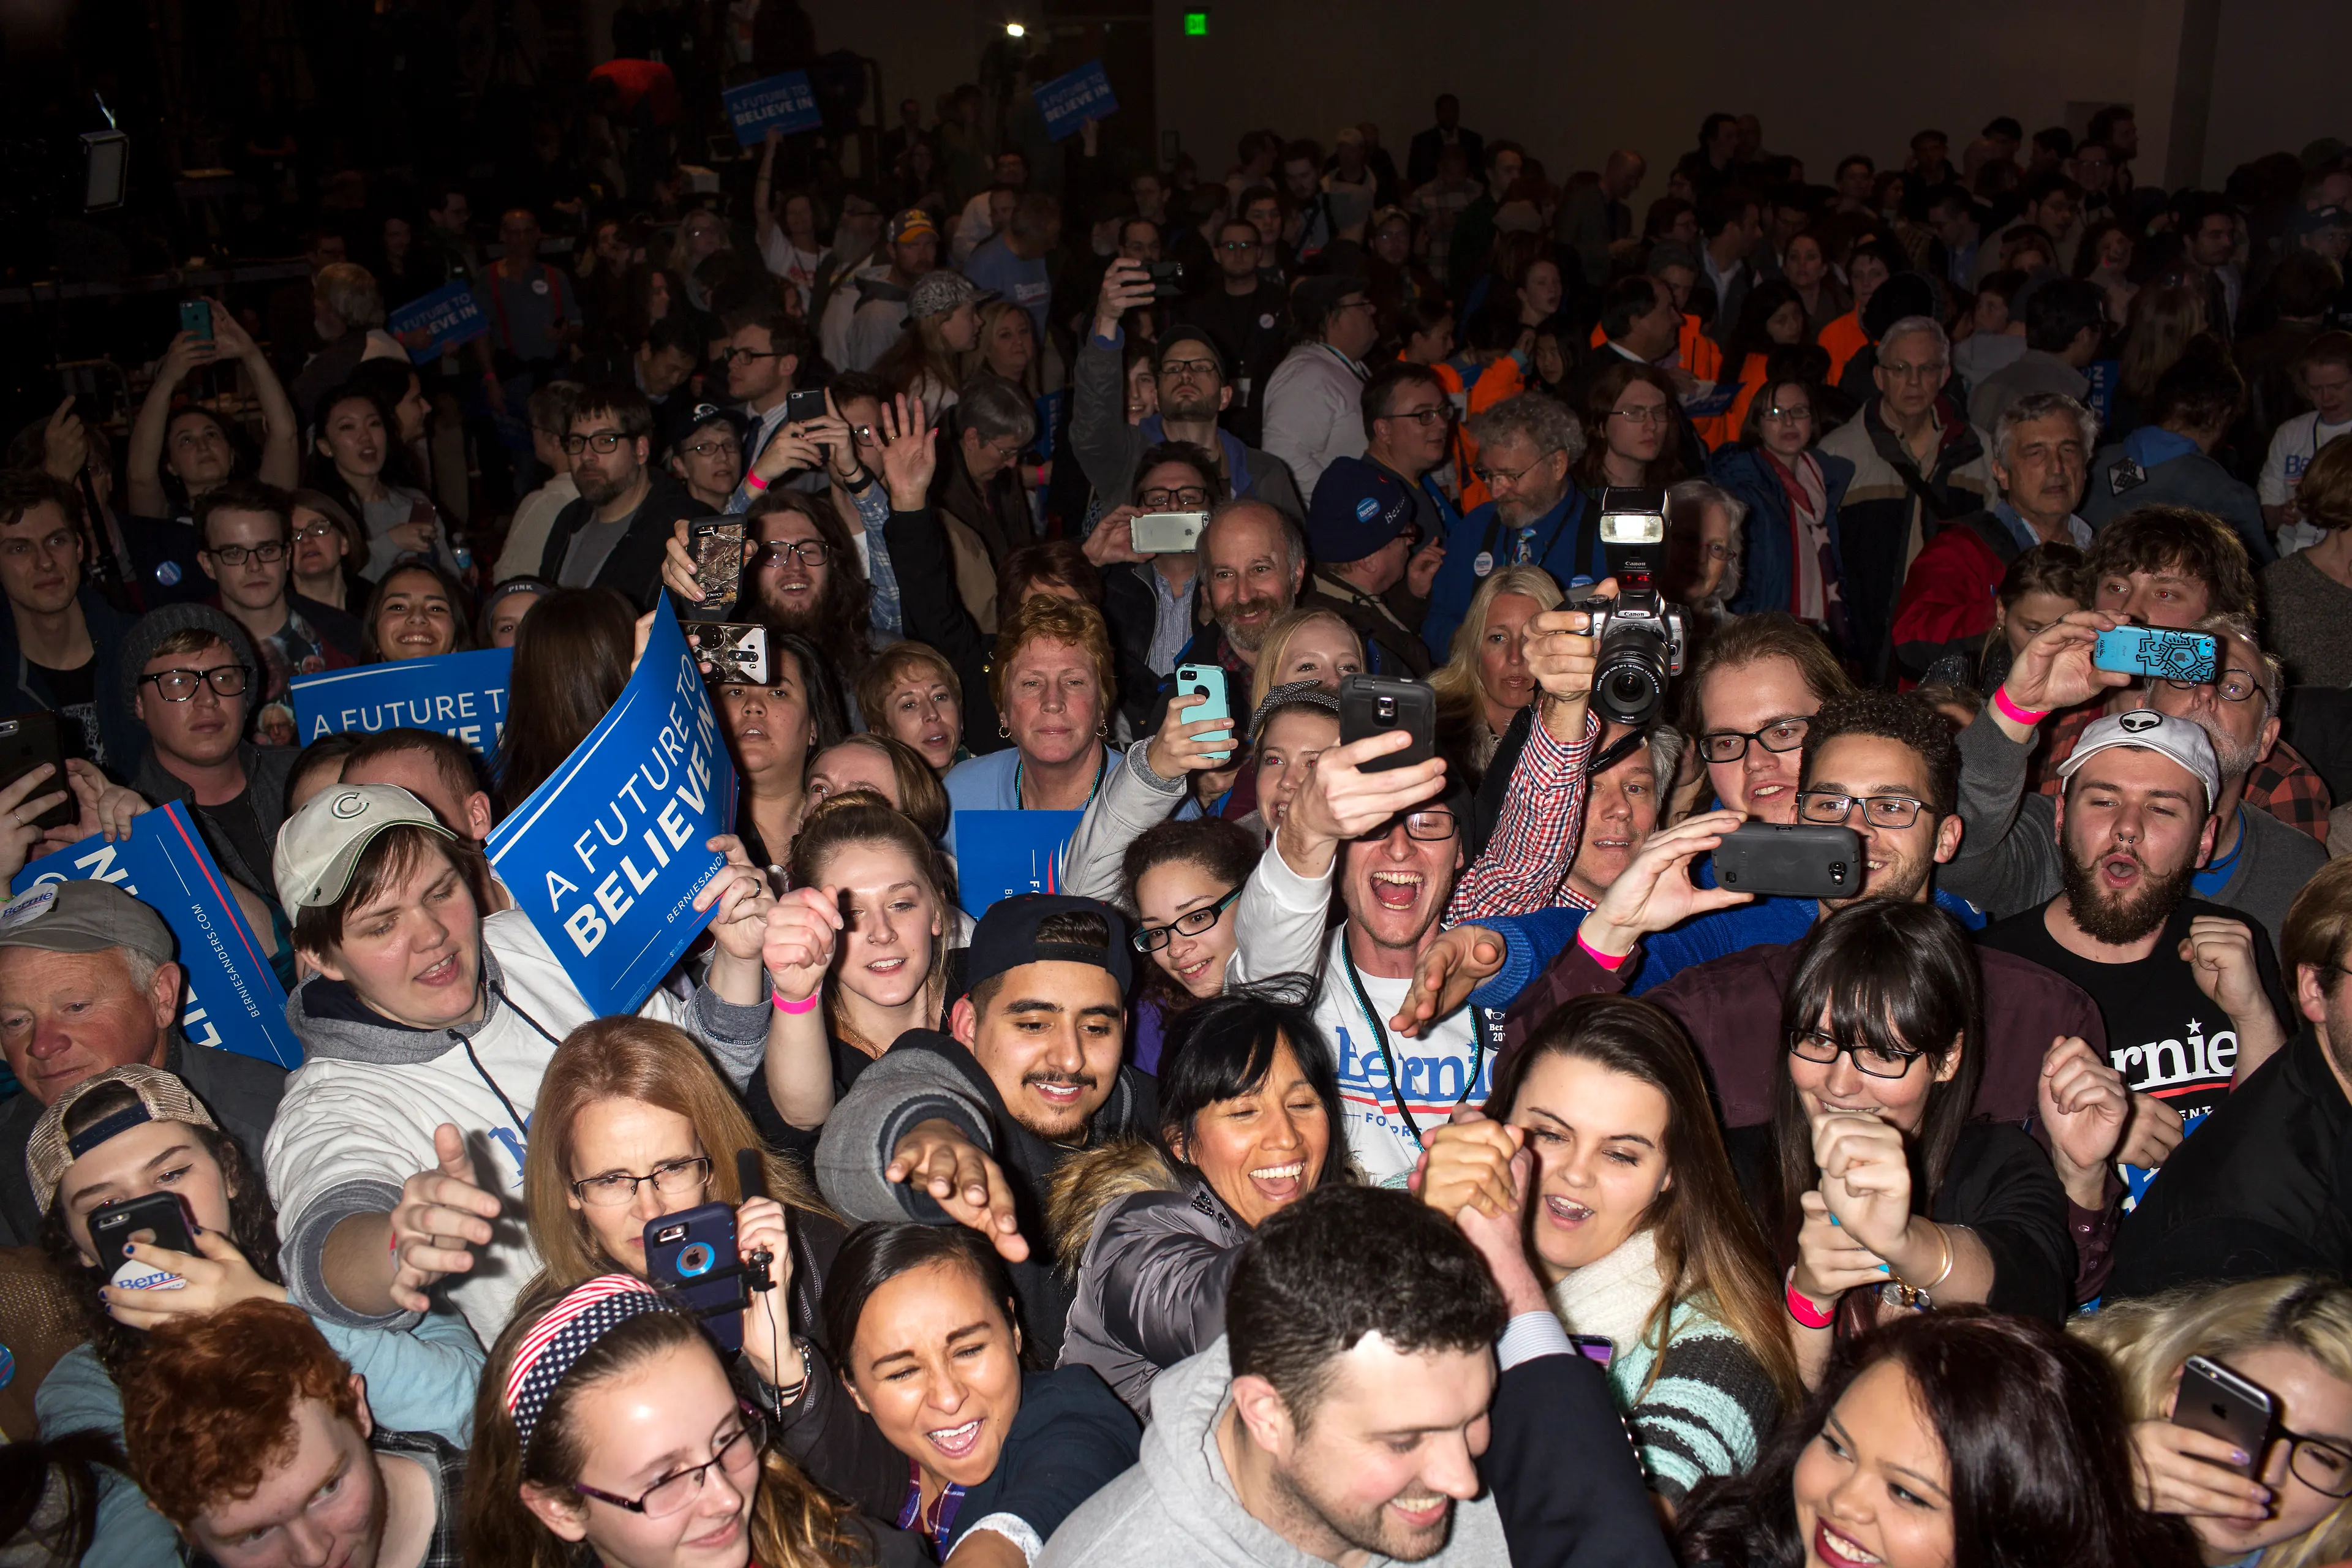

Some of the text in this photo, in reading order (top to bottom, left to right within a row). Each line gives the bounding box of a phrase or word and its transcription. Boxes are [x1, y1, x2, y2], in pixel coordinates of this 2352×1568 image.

[732, 83, 809, 111] A FUTURE TO
[1044, 83, 1110, 123] BELIEVE IN
[1048, 80, 1088, 106] FUTURE
[734, 96, 814, 126] BELIEVE IN
[402, 300, 451, 330] FUTURE
[451, 293, 470, 307] TO
[459, 303, 478, 321] IN
[508, 584, 533, 593] PINK
[313, 688, 504, 740] A FUTURE T
[545, 654, 696, 913] A FUTURE TO
[331, 791, 369, 820] C
[563, 692, 715, 958] BELIEVE IN
[666, 850, 727, 924] BERNIESANDE
[2, 892, 53, 919] Bernie
[190, 903, 260, 1018] BERNIESANDERS.COM
[2110, 1022, 2238, 1090] rnie
[1366, 1112, 1387, 1126] FO
[116, 1272, 178, 1289] Bern
